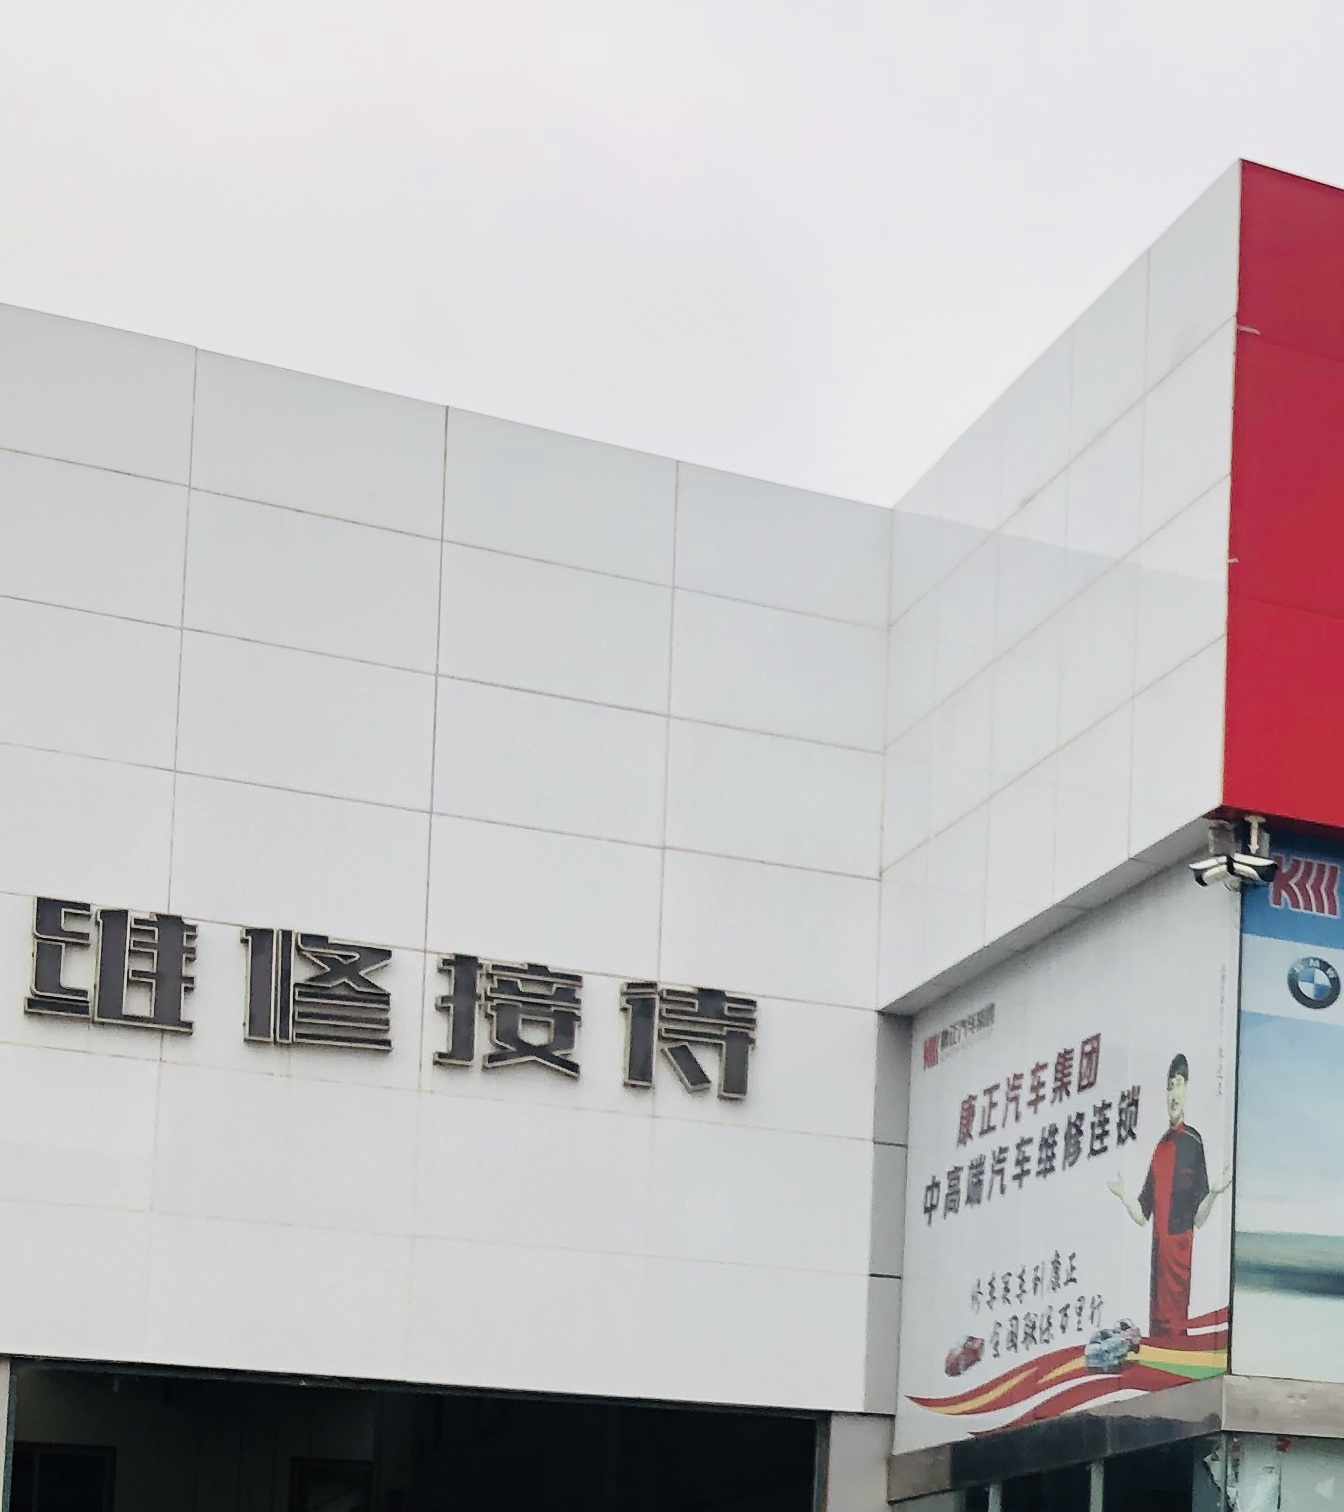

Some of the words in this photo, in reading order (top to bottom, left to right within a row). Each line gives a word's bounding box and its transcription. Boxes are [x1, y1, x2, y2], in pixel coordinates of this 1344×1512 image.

[23, 896, 758, 1101] 维修接待
[923, 1085, 1141, 1227] 中高端汽车维修连锁
[955, 1033, 1101, 1148] 康正汽车集团
